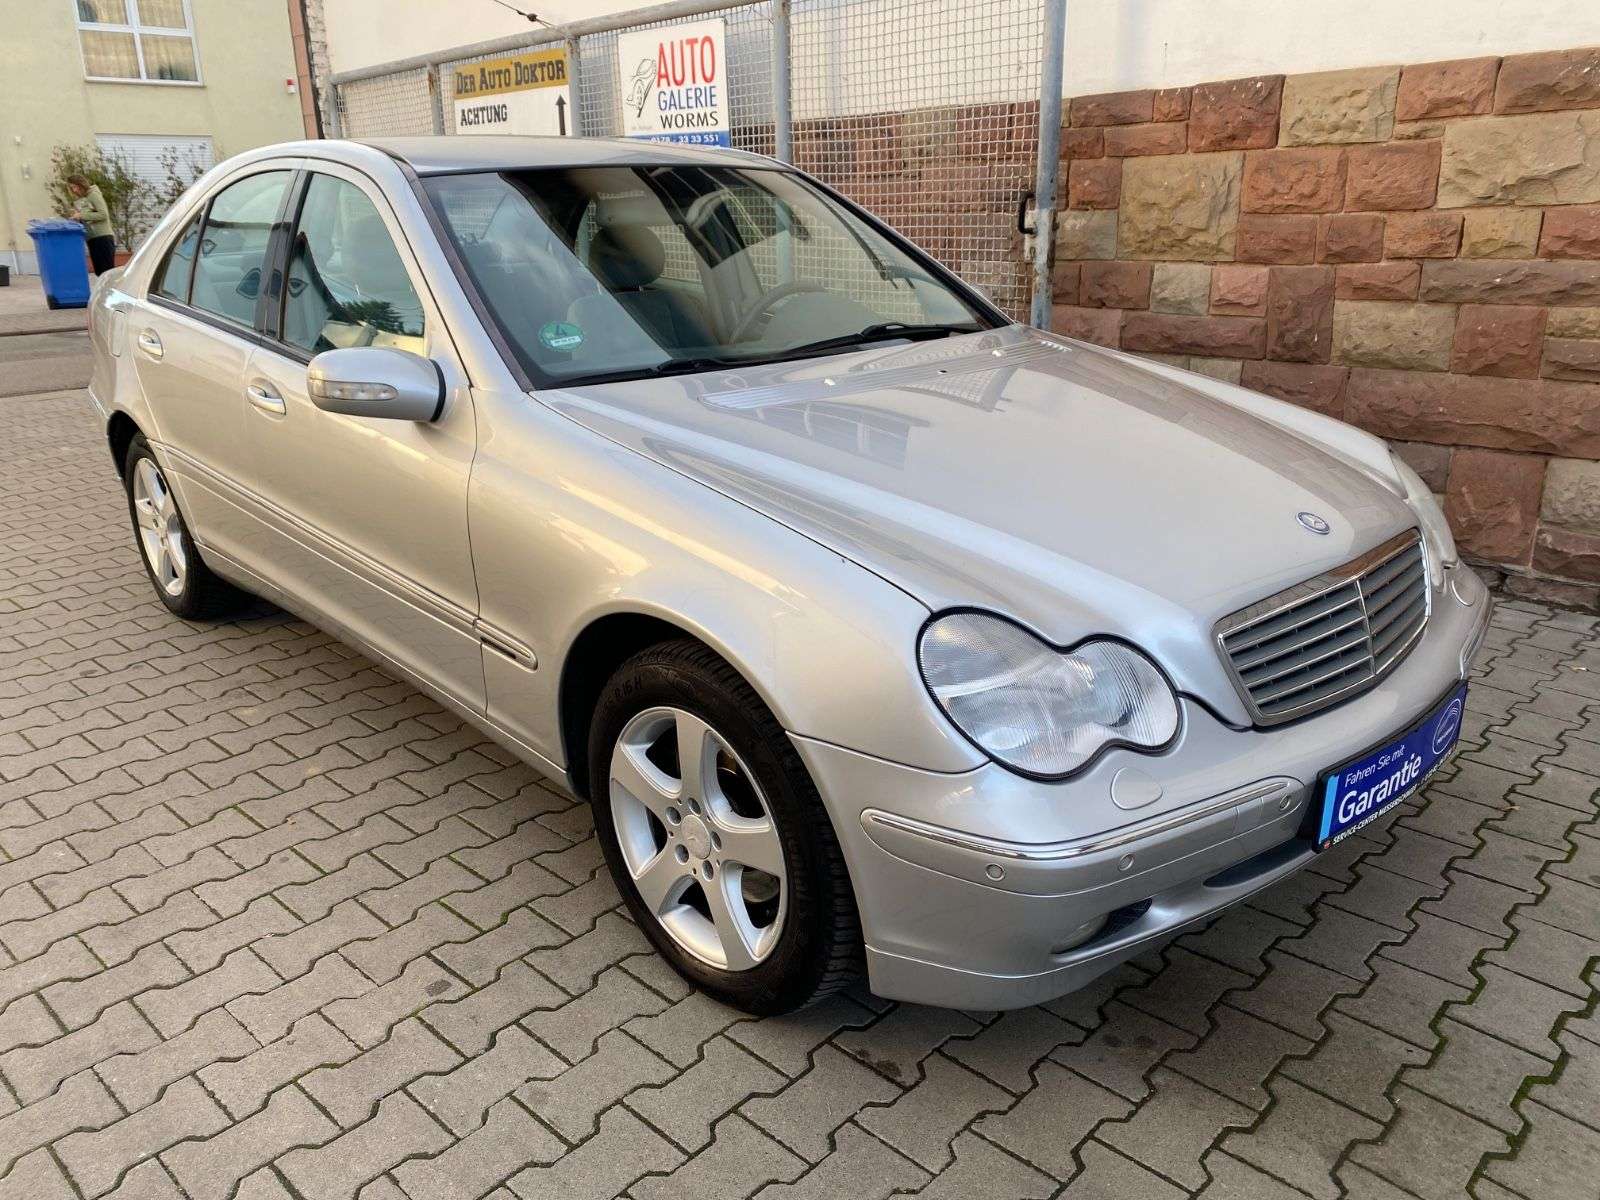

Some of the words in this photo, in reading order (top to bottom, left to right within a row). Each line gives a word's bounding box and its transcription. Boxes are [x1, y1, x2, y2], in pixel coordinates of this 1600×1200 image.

[656, 35, 716, 87] AUTO
[456, 71, 476, 94] DER
[480, 66, 511, 91] AUTO
[514, 59, 566, 86] DOKTOR
[658, 85, 717, 111] GALERIE
[460, 103, 508, 126] ACHTUNG
[660, 110, 718, 129] WORMS
[679, 136, 689, 144] 33
[691, 135, 701, 143] 33
[703, 134, 719, 143] 551
[1345, 763, 1376, 788] Fahren
[1377, 754, 1391, 770] Sie
[1391, 744, 1406, 761] mit
[1338, 753, 1421, 823] Garantie
